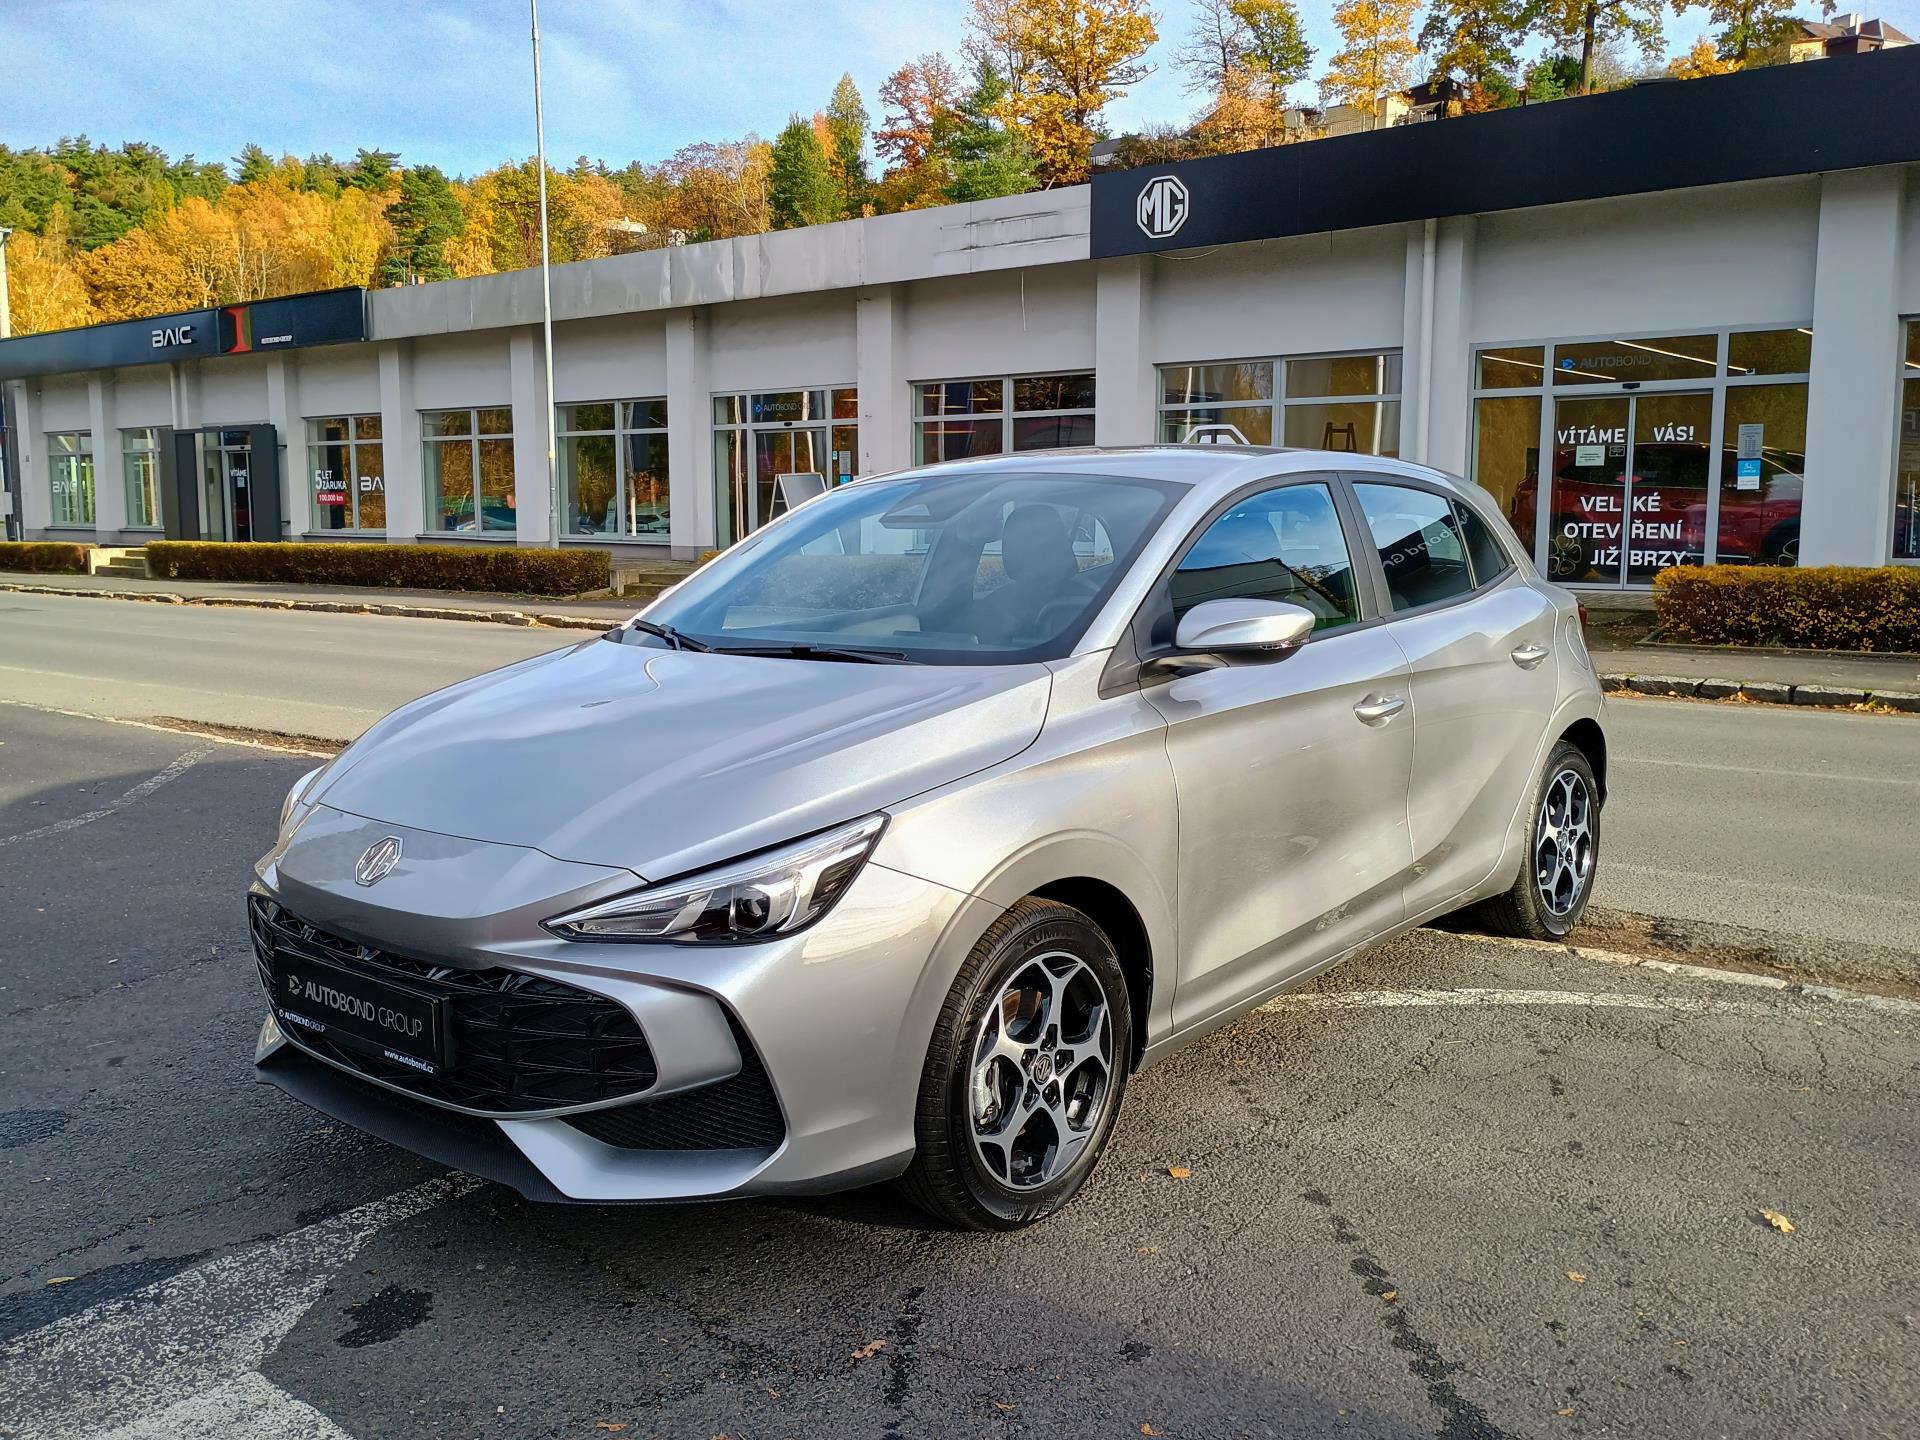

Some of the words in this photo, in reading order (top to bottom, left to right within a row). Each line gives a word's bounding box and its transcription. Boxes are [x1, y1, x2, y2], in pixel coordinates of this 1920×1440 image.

[1139, 179, 1186, 235] MG
[151, 325, 192, 347] BAIC
[1579, 355, 1651, 369] AUTOBOND
[763, 402, 797, 412] AUTOBOND
[1557, 425, 1625, 444] VÍTÁME
[1653, 422, 1694, 442] VÁS!
[314, 469, 322, 490] 5
[322, 470, 332, 480] LET
[360, 476, 385, 491] BA
[1590, 546, 1619, 565] JIŽ
[1629, 550, 1687, 567] BRZY
[357, 838, 401, 884] MG
[284, 1011, 310, 1027] AUTOBOND
[304, 981, 375, 1022] AUTOBOND
[378, 1007, 422, 1038] GROUP
[384, 1049, 434, 1075] www.autobond.cz
